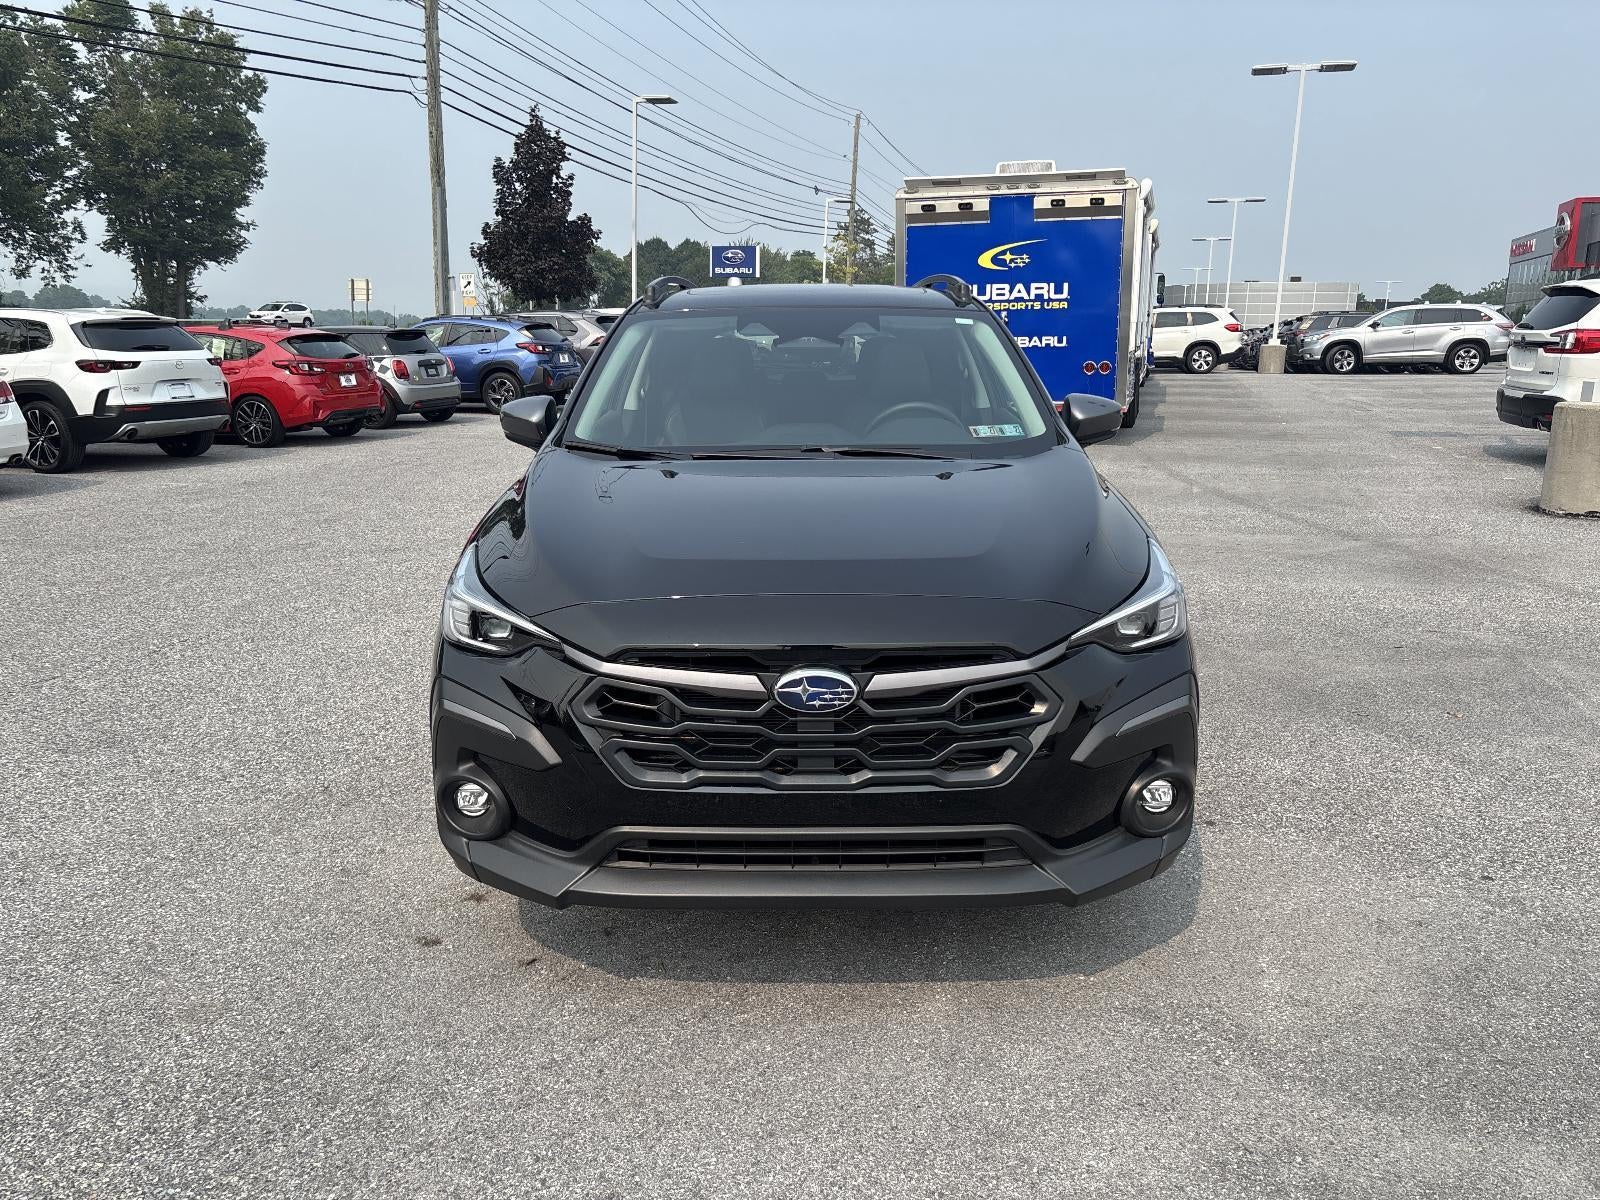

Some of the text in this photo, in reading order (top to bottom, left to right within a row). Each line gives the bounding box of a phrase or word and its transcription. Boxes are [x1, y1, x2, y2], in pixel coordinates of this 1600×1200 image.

[969, 282, 1069, 301] UBARU
[986, 301, 1068, 311] RSPORTS USA
[1014, 336, 1067, 348] BARU
